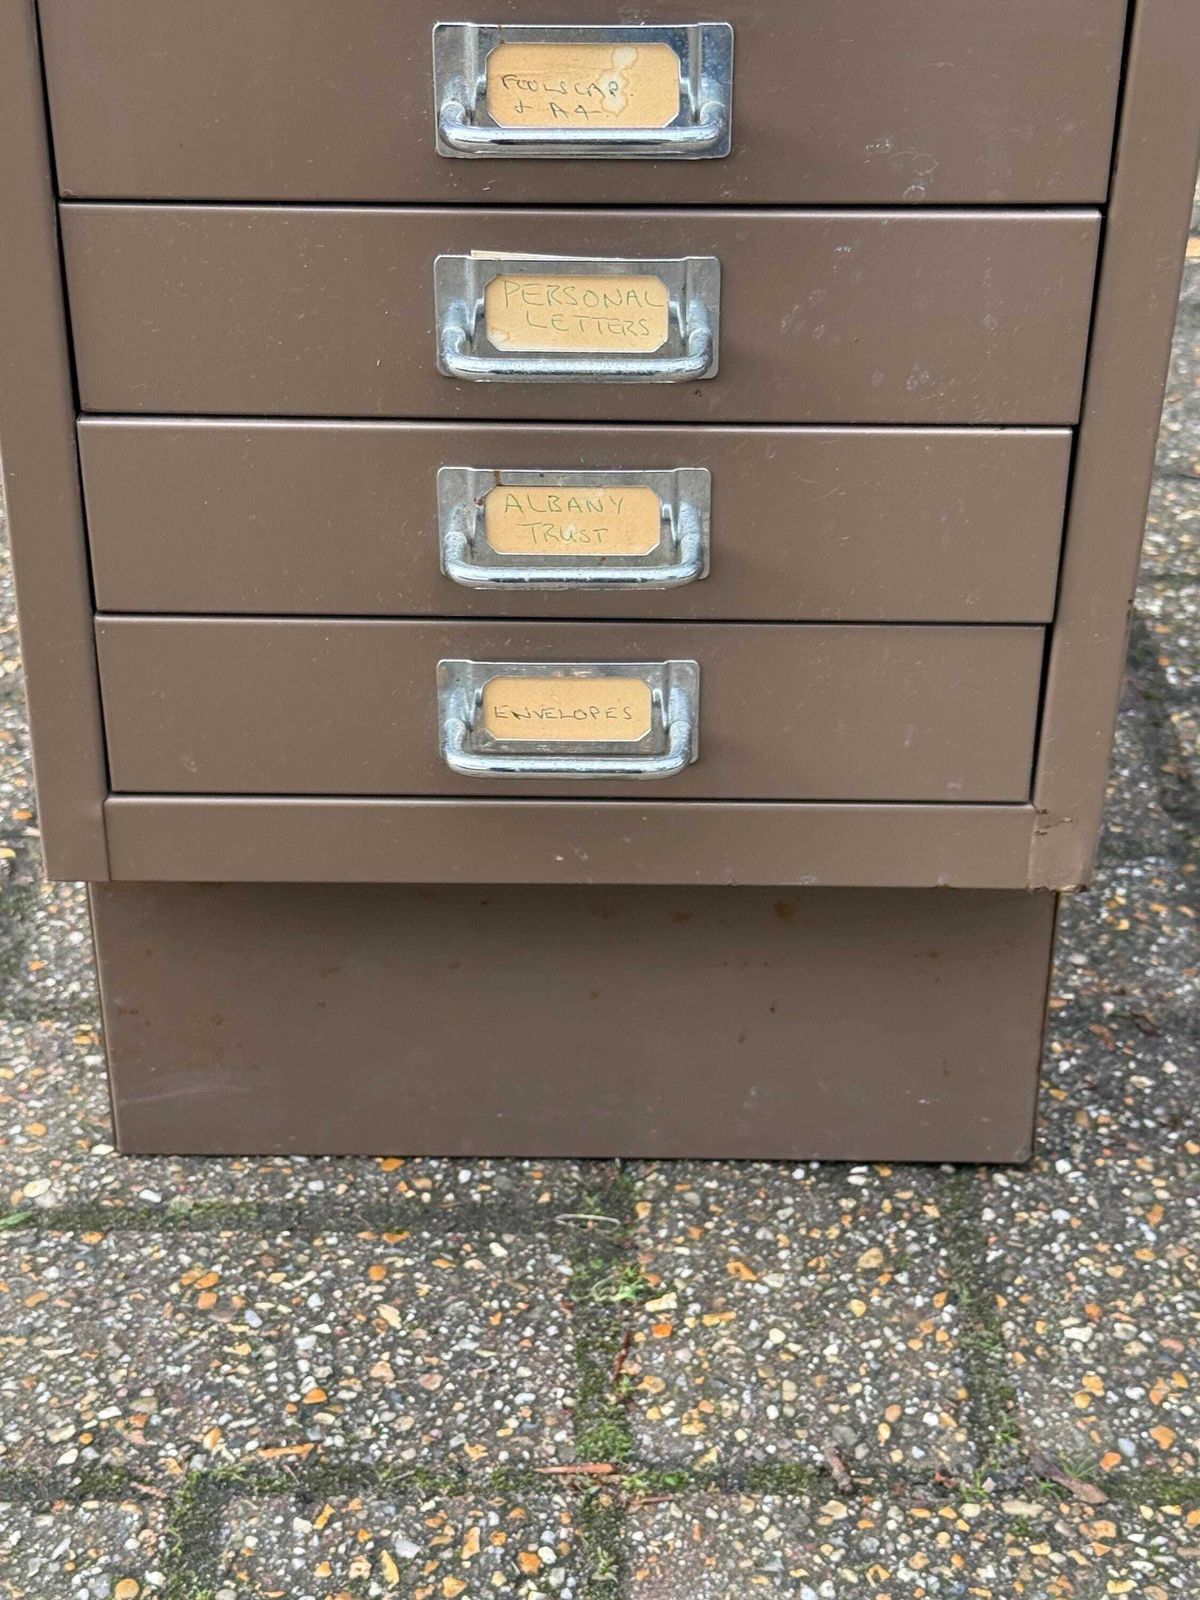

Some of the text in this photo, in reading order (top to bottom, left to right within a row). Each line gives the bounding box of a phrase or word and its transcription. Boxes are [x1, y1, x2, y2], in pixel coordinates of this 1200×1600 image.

[503, 280, 665, 308] PERSONAL
[526, 310, 650, 337] LETTERS
[504, 493, 624, 515] ALBANY
[519, 521, 609, 544] TRUST
[494, 704, 632, 721] ENVELOPES
